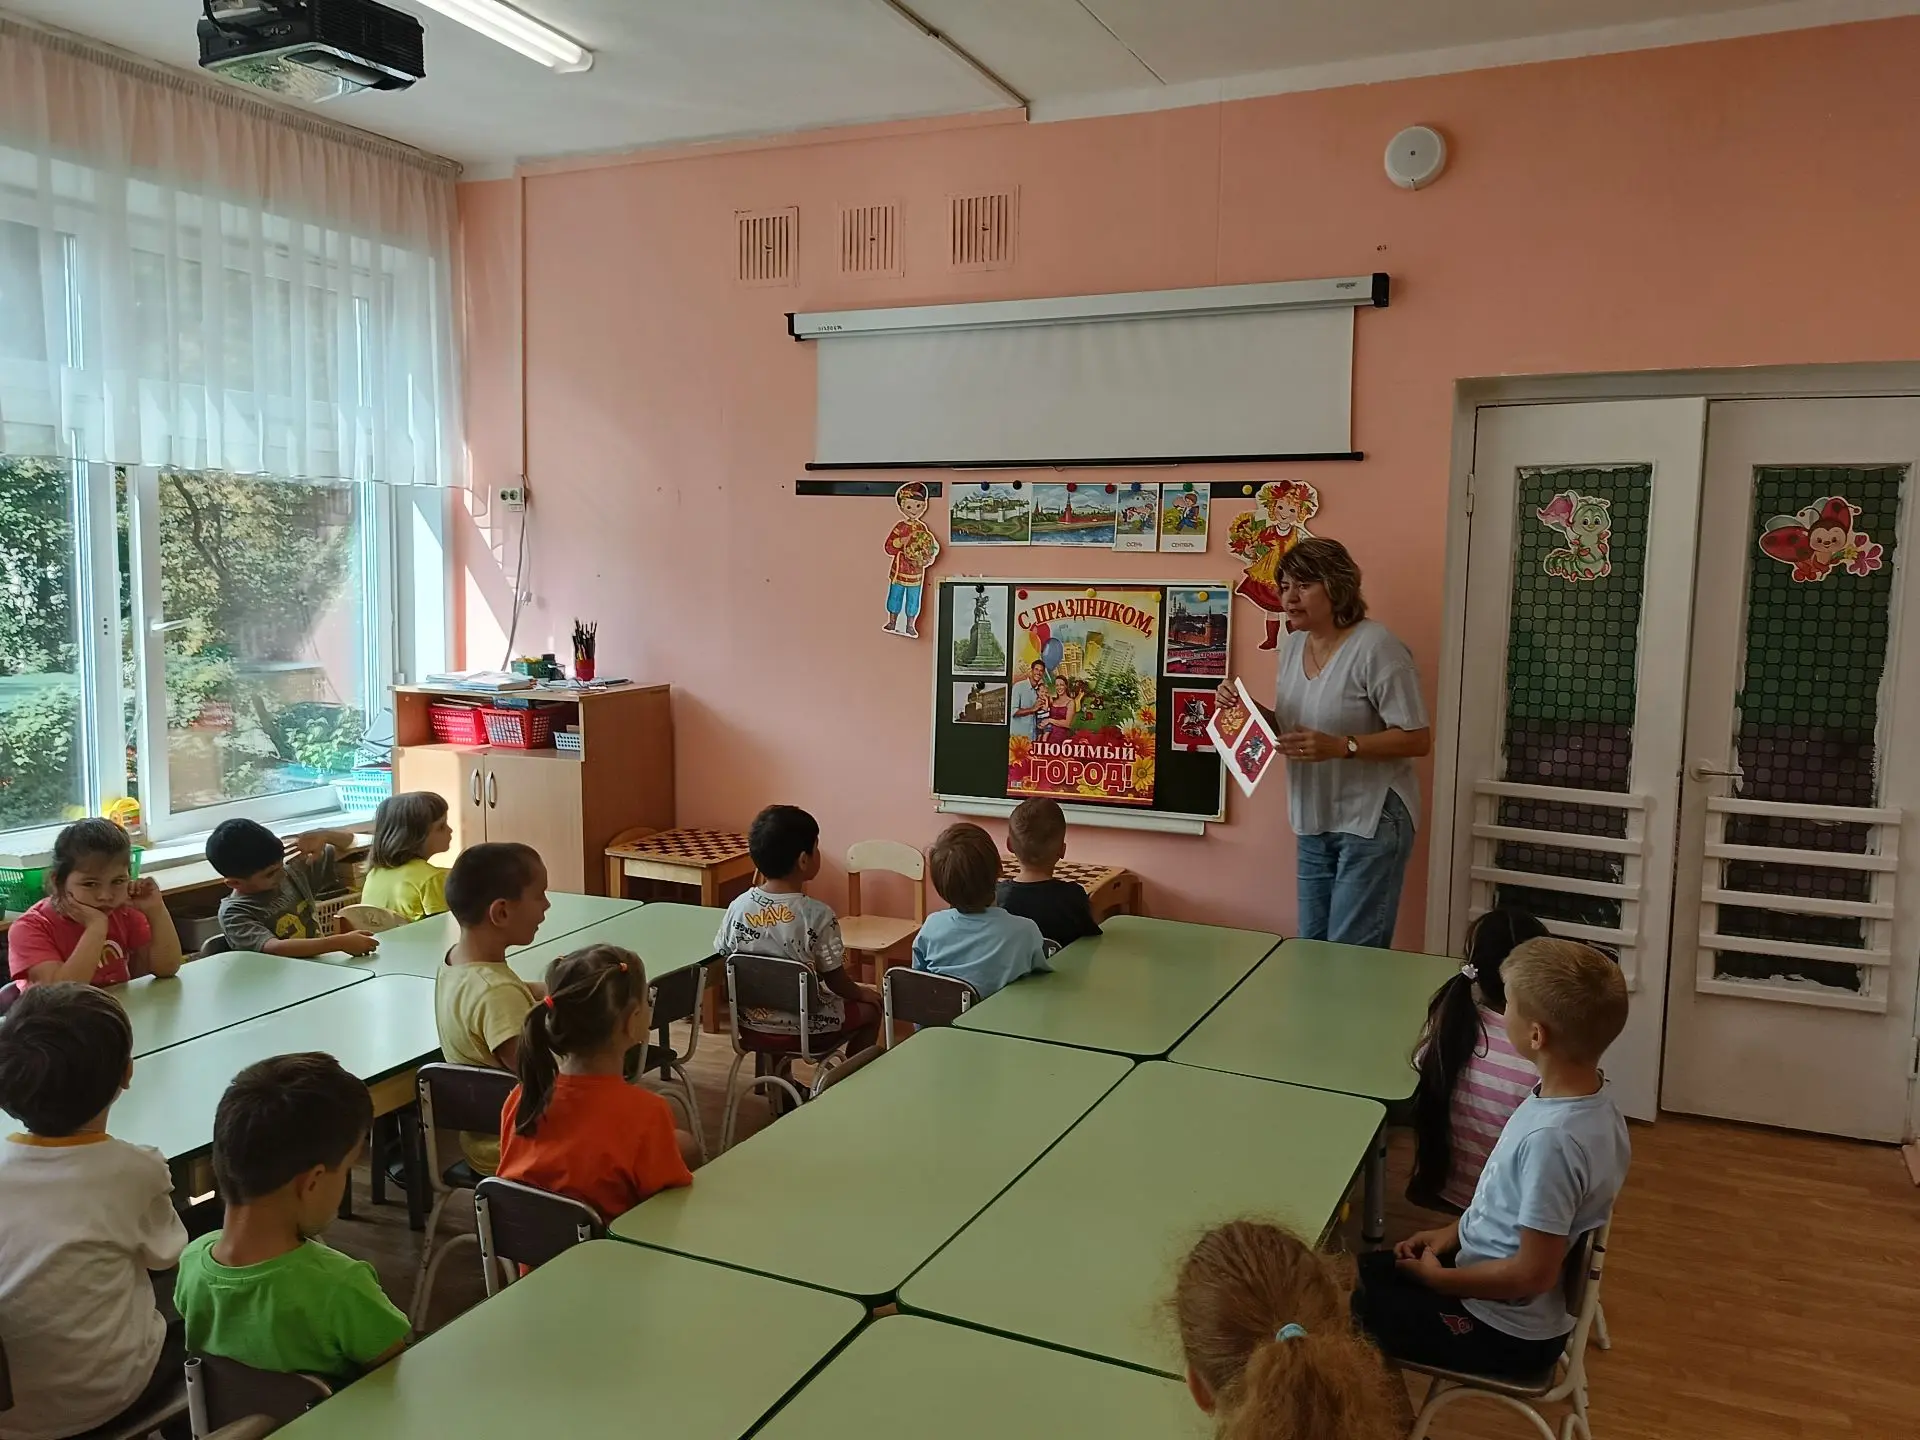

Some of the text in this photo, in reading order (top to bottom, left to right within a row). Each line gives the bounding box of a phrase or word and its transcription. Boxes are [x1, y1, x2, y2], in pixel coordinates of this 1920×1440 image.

[1017, 598, 1155, 639] С ПРАЗДНИКОМ,
[1030, 759, 1133, 792] ГОРОД!
[744, 904, 796, 929] WAVE
